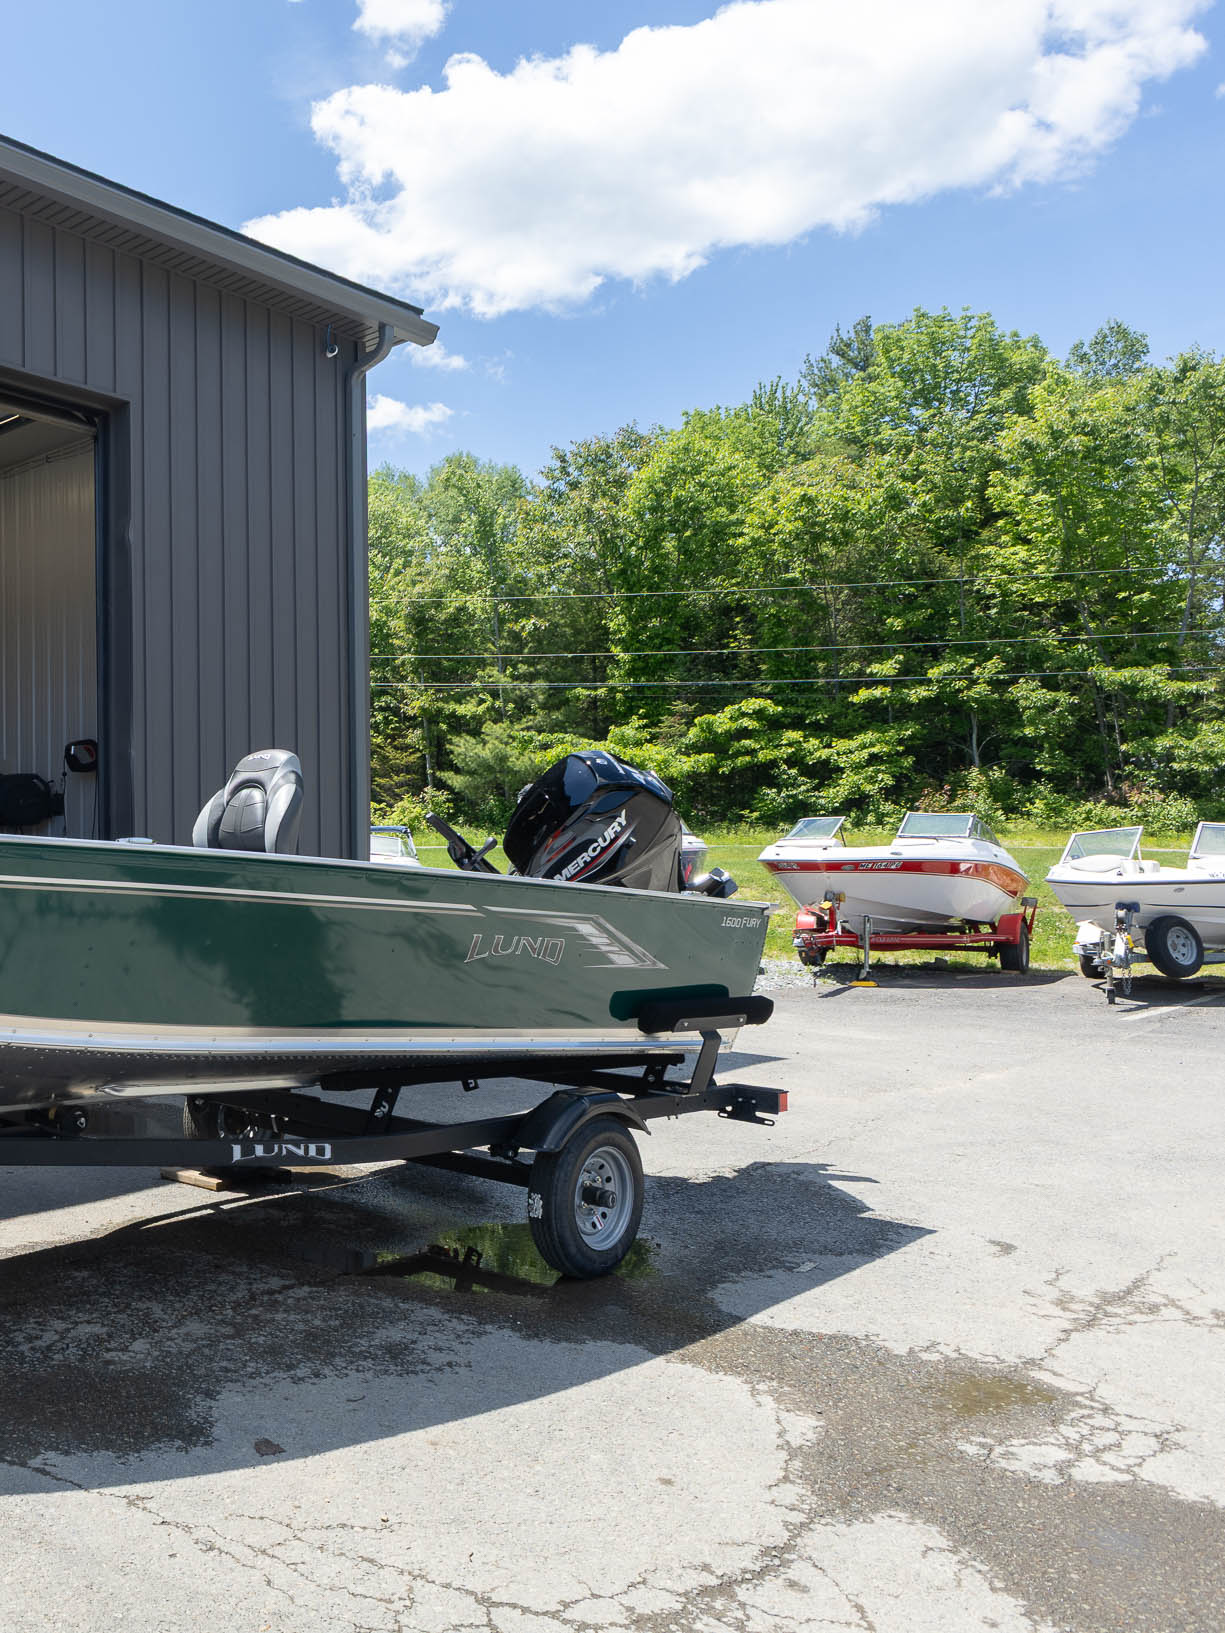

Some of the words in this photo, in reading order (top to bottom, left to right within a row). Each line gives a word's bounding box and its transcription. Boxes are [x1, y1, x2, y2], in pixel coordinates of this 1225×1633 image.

[553, 808, 627, 881] MERCURY
[720, 916, 742, 928] 1600
[740, 916, 762, 929] FURY
[463, 933, 566, 966] LUND
[231, 1143, 332, 1163] LUND
